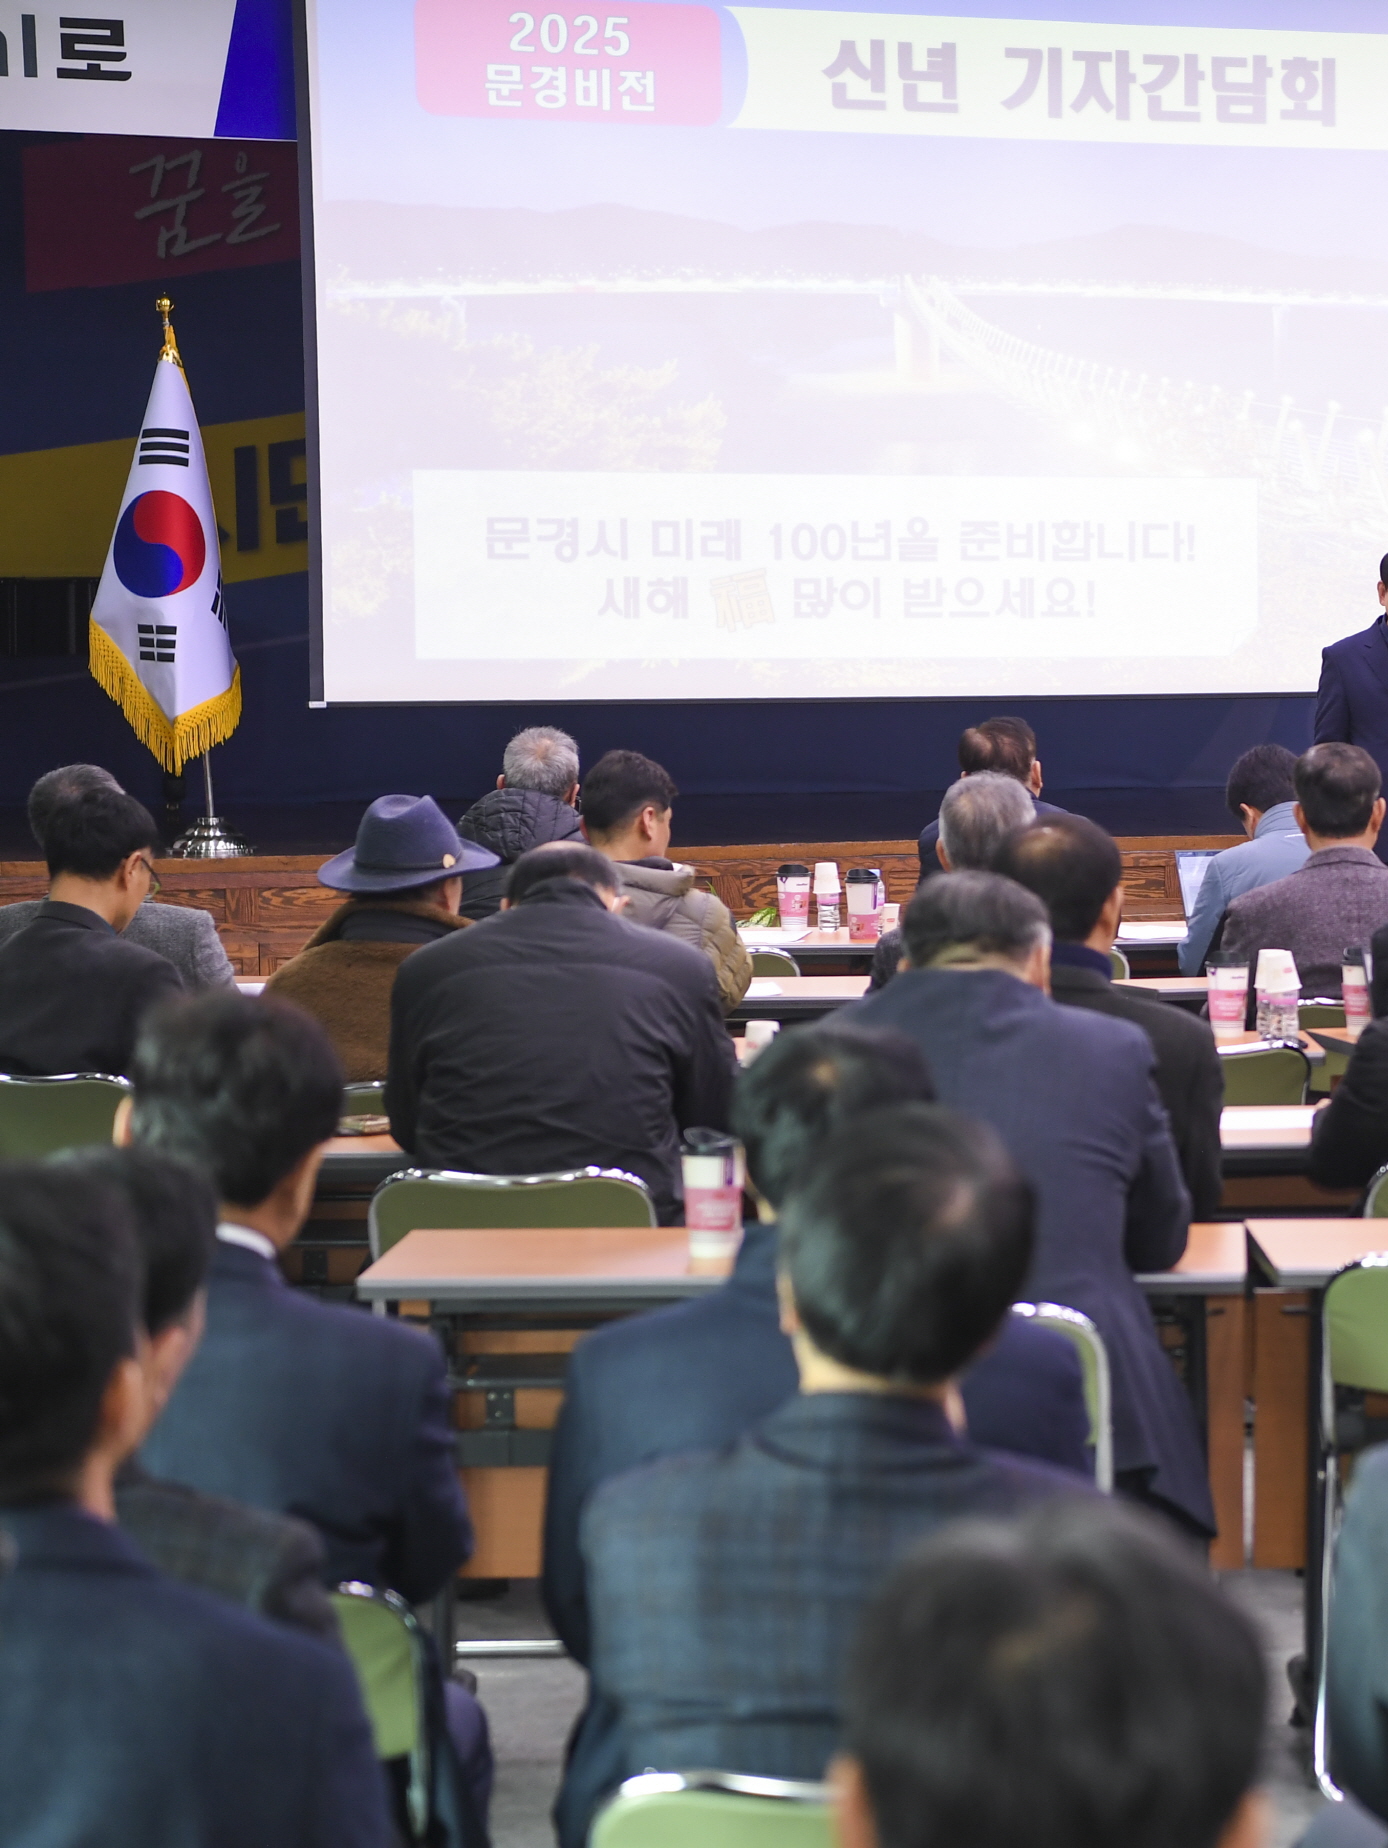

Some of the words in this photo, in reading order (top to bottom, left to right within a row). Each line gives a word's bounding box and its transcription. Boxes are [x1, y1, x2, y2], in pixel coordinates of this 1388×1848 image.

[509, 12, 631, 57] 2025
[484, 64, 656, 113] 문경비전
[821, 38, 960, 114] 신년
[1001, 46, 1338, 127] 기자간담회
[129, 149, 281, 260] 꿈을
[485, 515, 630, 564] 문경시
[651, 517, 742, 562] 미래
[768, 515, 940, 563] 100년을
[959, 518, 1197, 563] 준비합니다!
[597, 576, 690, 620] 새해
[793, 576, 882, 620] 많이
[903, 576, 1097, 620] 받으세요!
